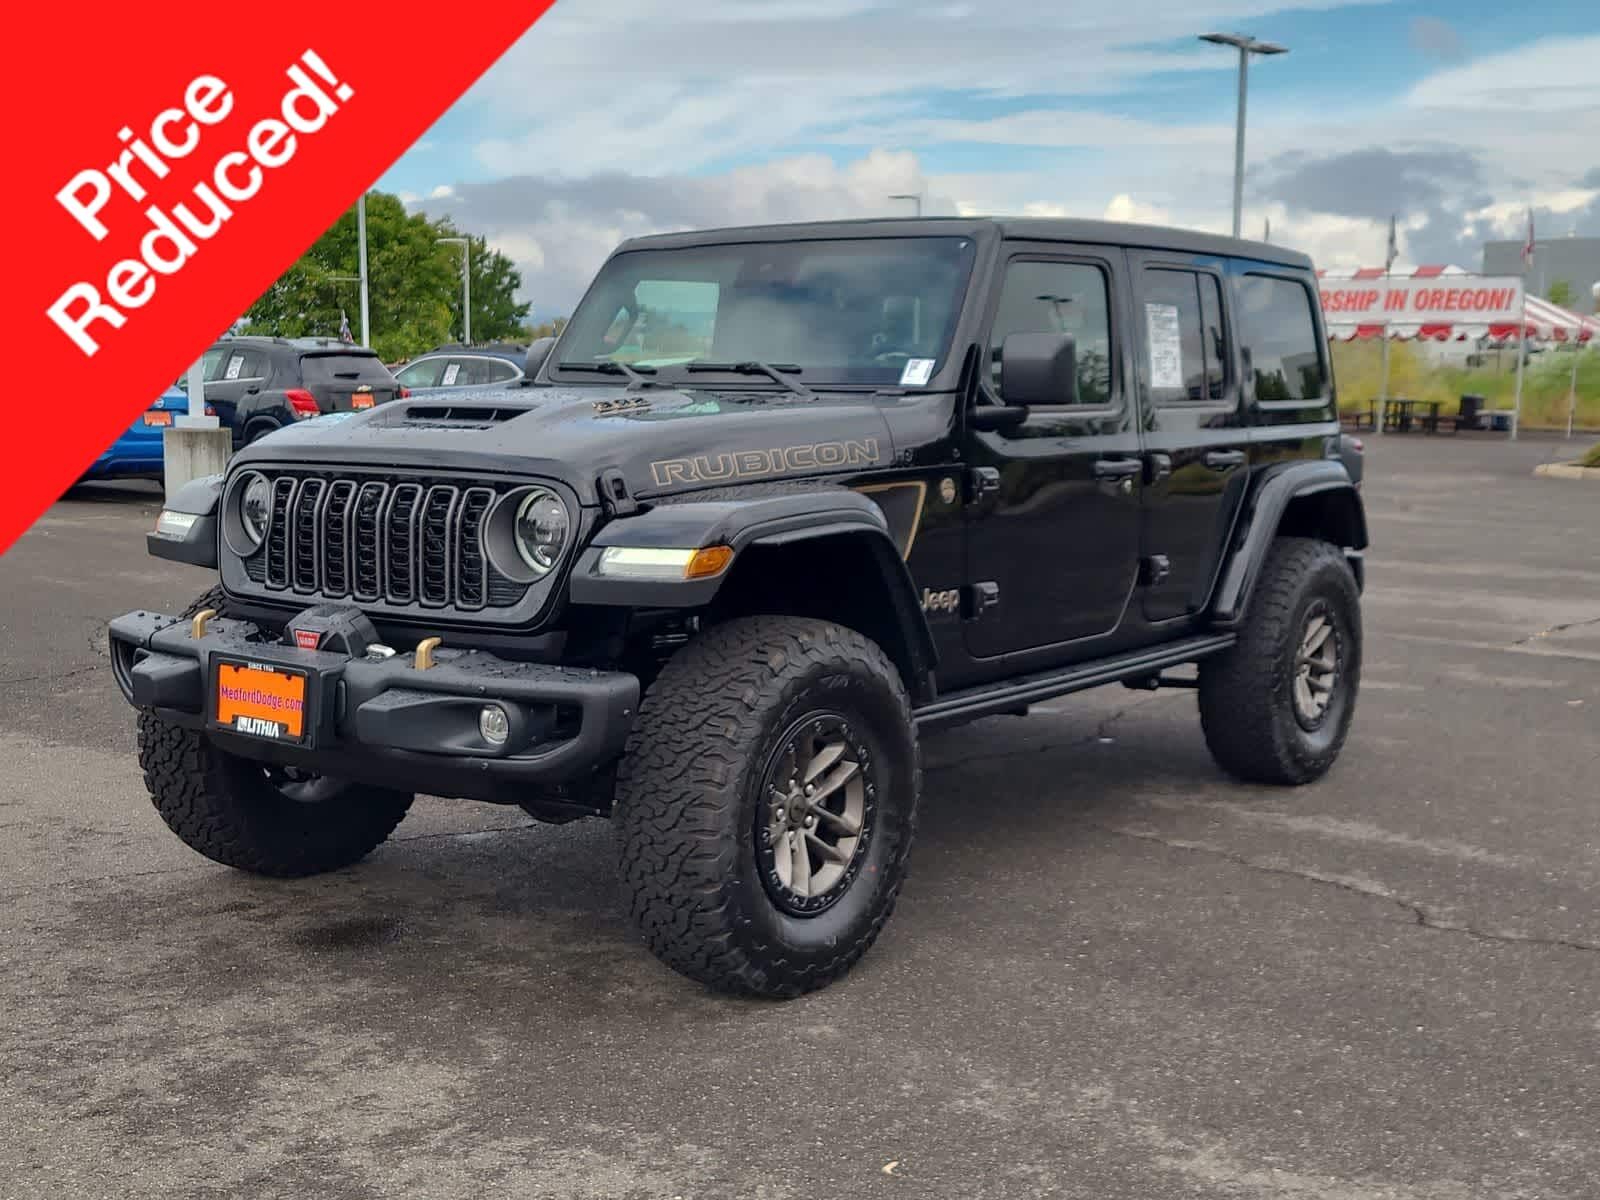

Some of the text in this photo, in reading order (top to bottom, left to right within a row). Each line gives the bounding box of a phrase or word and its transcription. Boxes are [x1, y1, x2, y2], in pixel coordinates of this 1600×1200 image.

[1384, 289, 1409, 311] IN
[1414, 287, 1516, 311] OREGON!
[651, 439, 881, 486] RUBICON
[920, 588, 960, 613] Jeep
[221, 685, 304, 711] MedfordDodge.com
[247, 717, 279, 738] LITHIA
